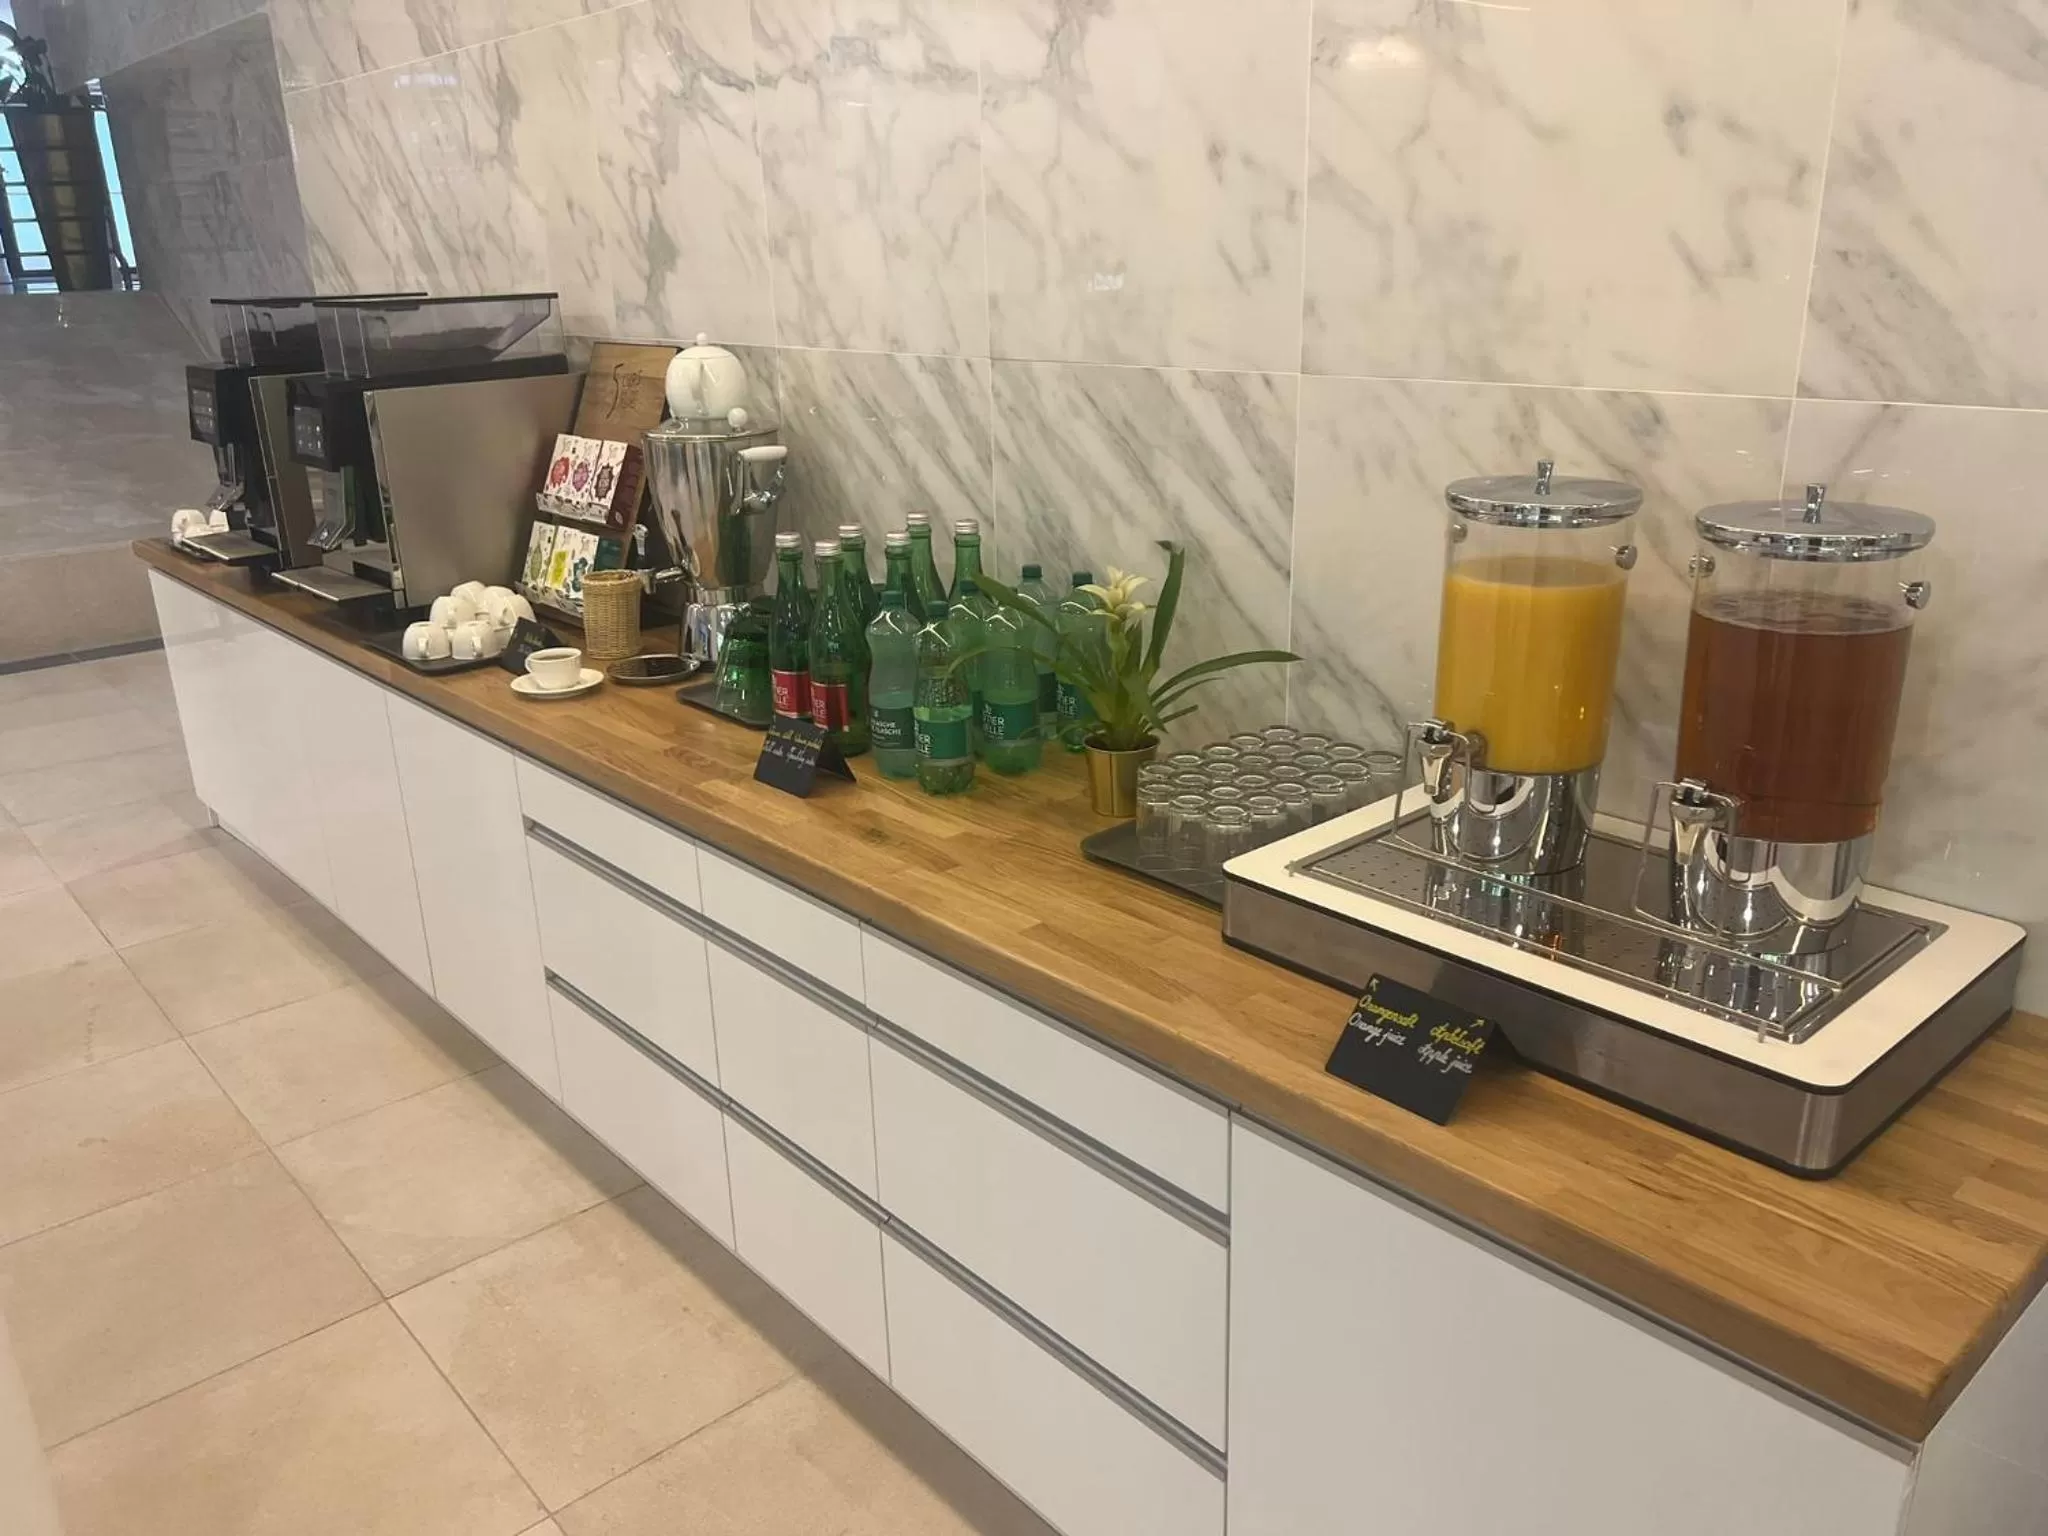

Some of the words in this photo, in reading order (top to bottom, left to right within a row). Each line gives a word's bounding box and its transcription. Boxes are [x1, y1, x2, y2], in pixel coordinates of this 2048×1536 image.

[1349, 1012, 1382, 1042] Orange
[1376, 1028, 1406, 1046] juice
[1417, 1043, 1452, 1064] Apple
[1440, 1055, 1472, 1074] juice
